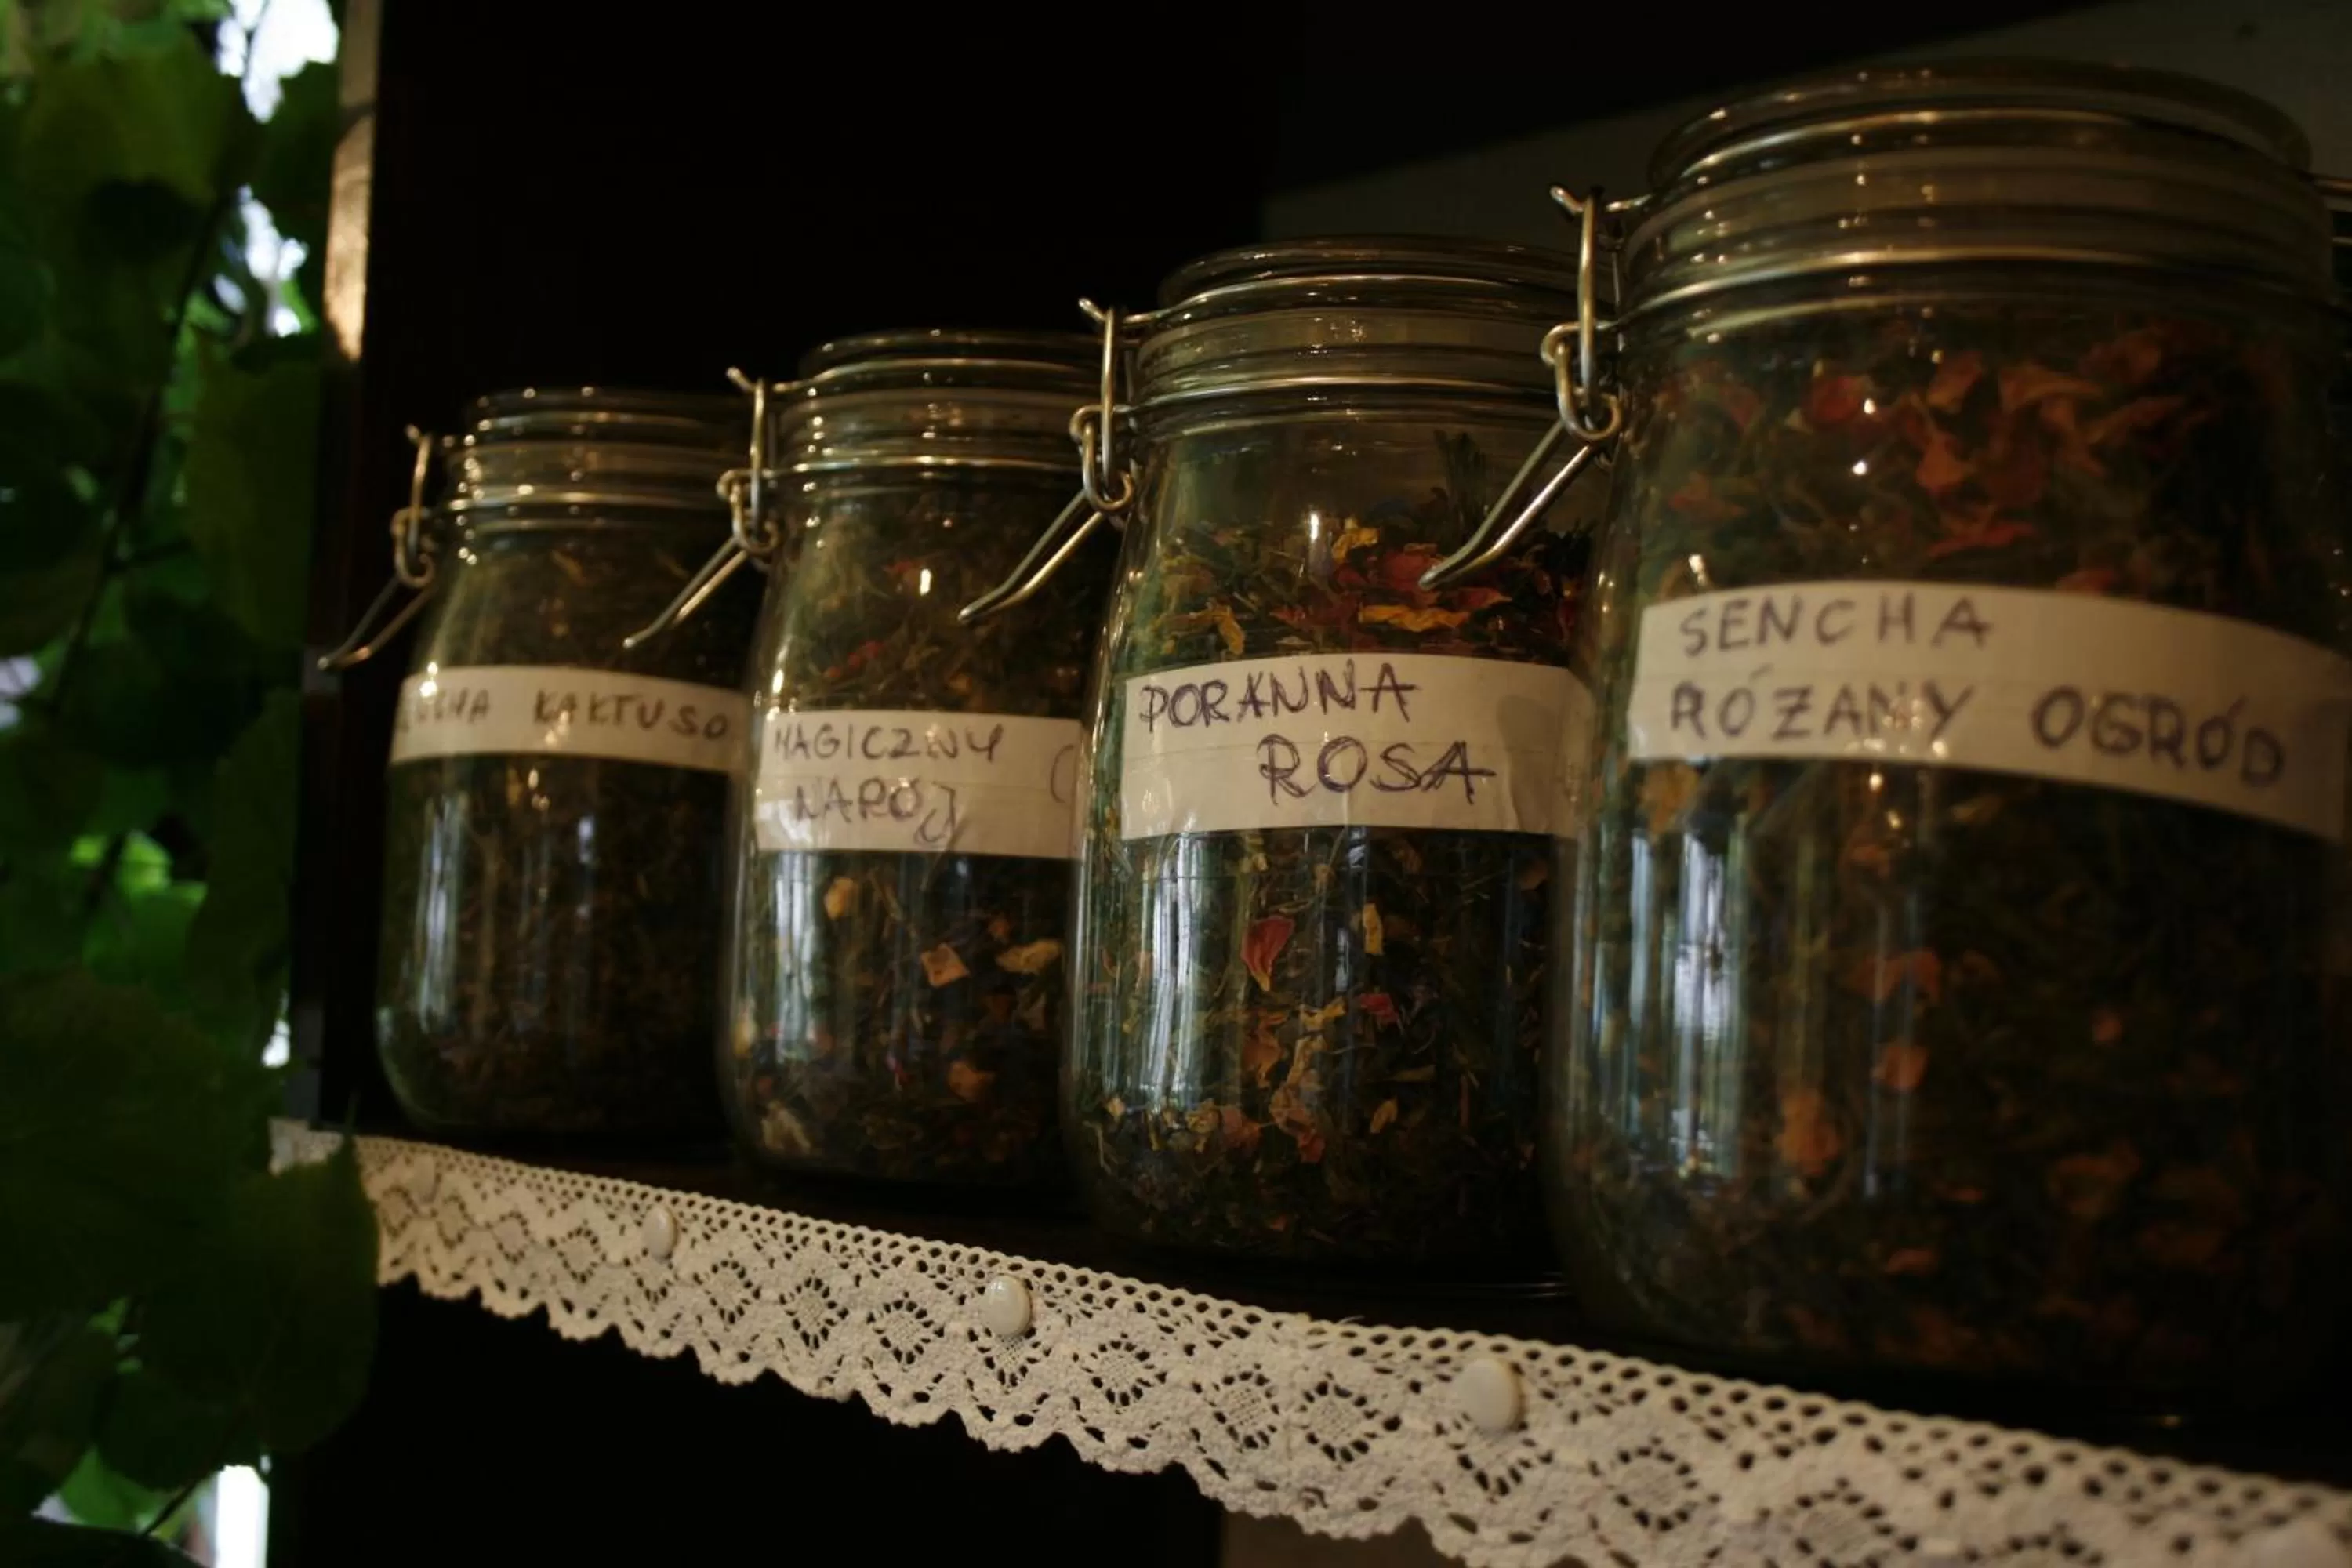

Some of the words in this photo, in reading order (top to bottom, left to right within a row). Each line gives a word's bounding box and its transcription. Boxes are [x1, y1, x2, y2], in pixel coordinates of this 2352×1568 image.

[1678, 596, 1994, 657] SENCHA
[1139, 659, 1421, 733] PORANNA
[1258, 731, 1496, 807] ROSA
[2031, 684, 2287, 789] OGRÓD
